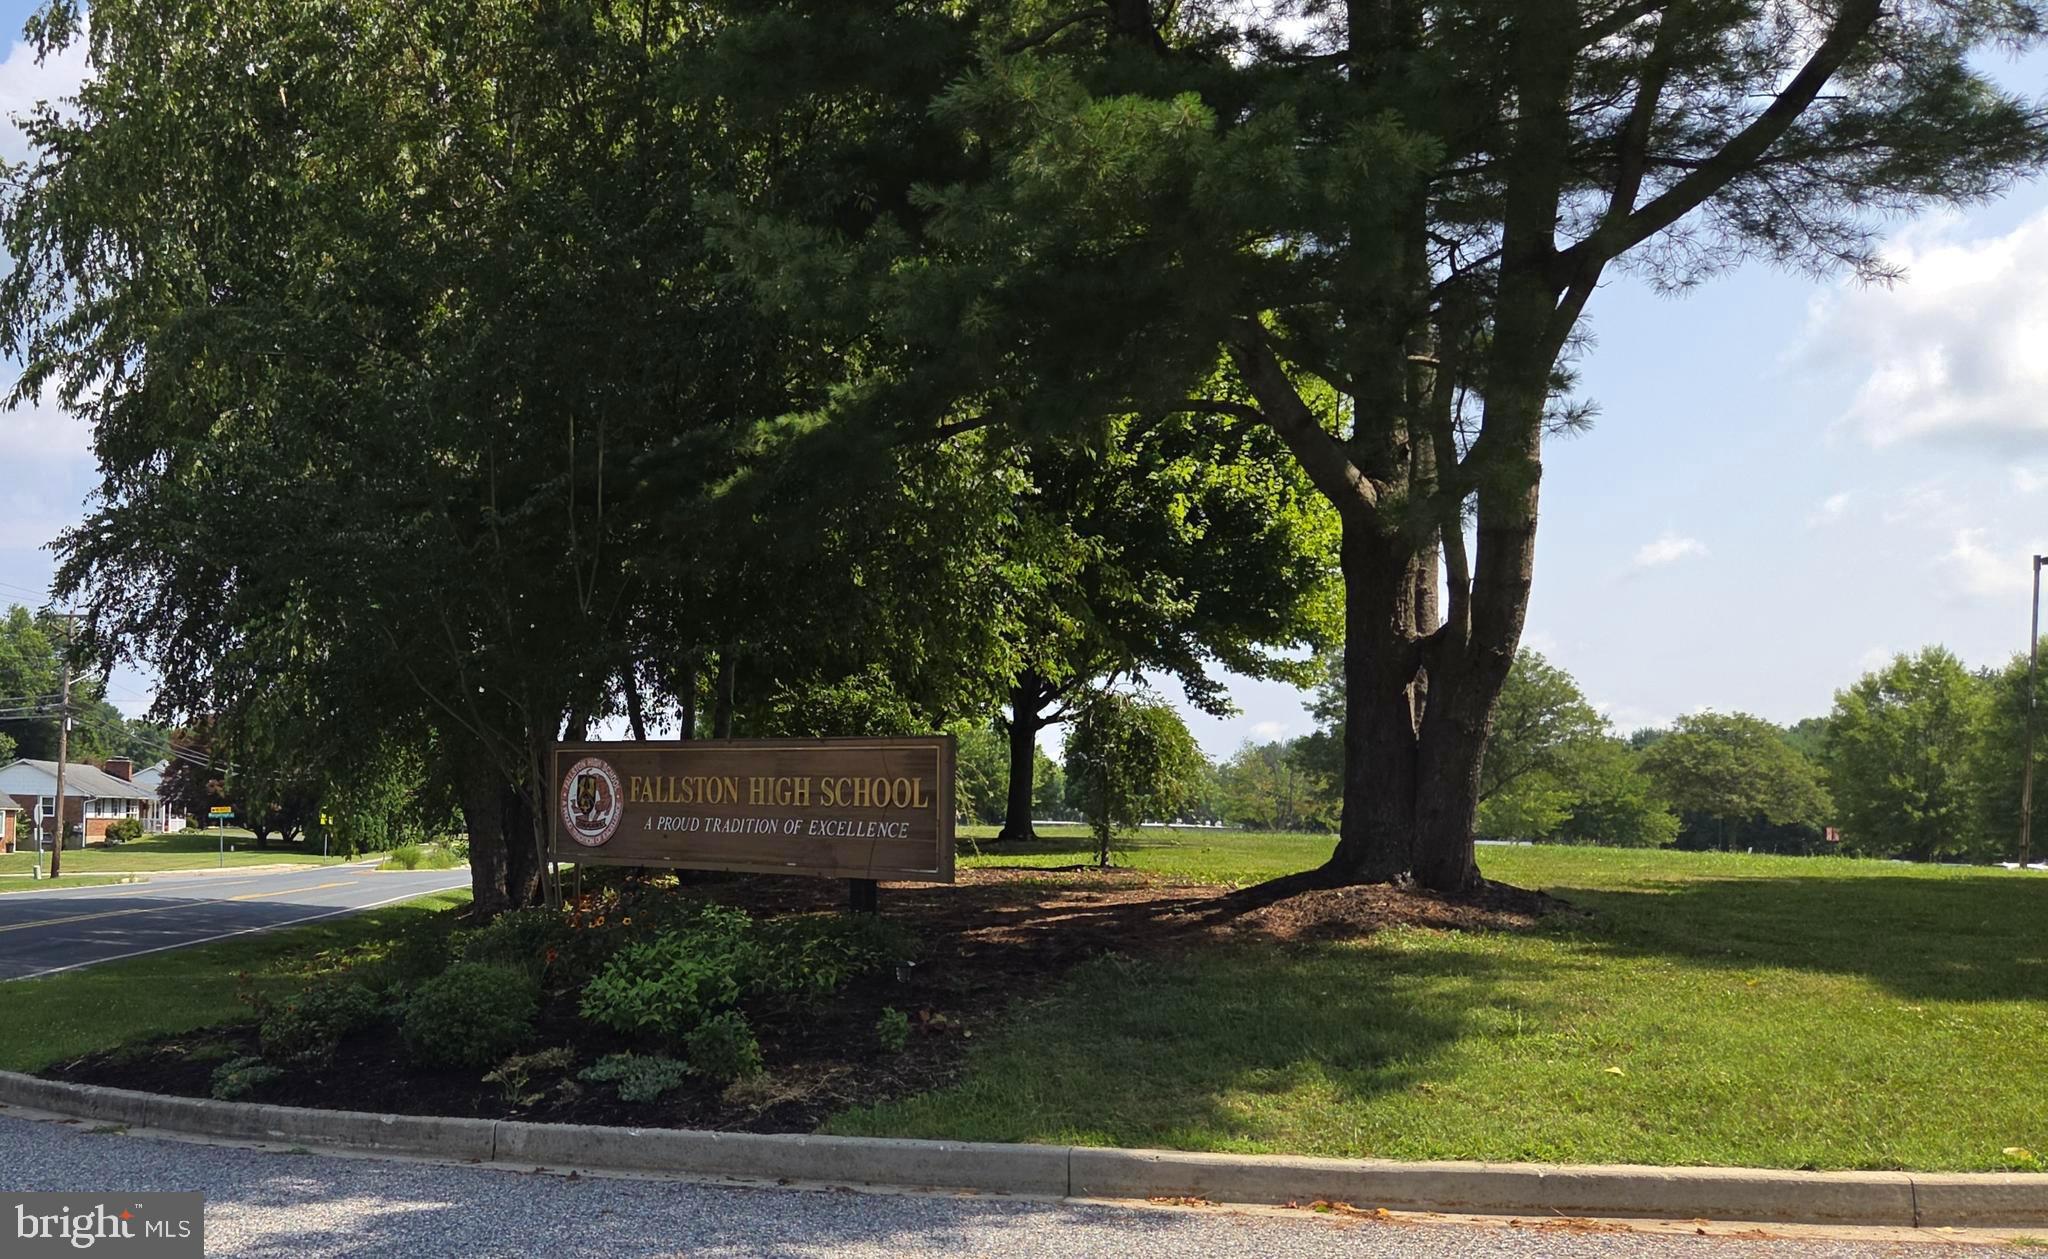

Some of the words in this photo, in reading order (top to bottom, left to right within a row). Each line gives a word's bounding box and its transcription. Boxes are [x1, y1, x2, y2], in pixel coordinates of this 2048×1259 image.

[630, 776, 739, 804] FALLSTON
[748, 776, 811, 806] HIGH
[820, 776, 929, 808] SCHOOL
[643, 816, 652, 831] A
[656, 816, 700, 832] PROUD
[704, 817, 779, 835] TRADITION
[783, 819, 803, 835] OF
[808, 820, 910, 839] EXCELLENCE
